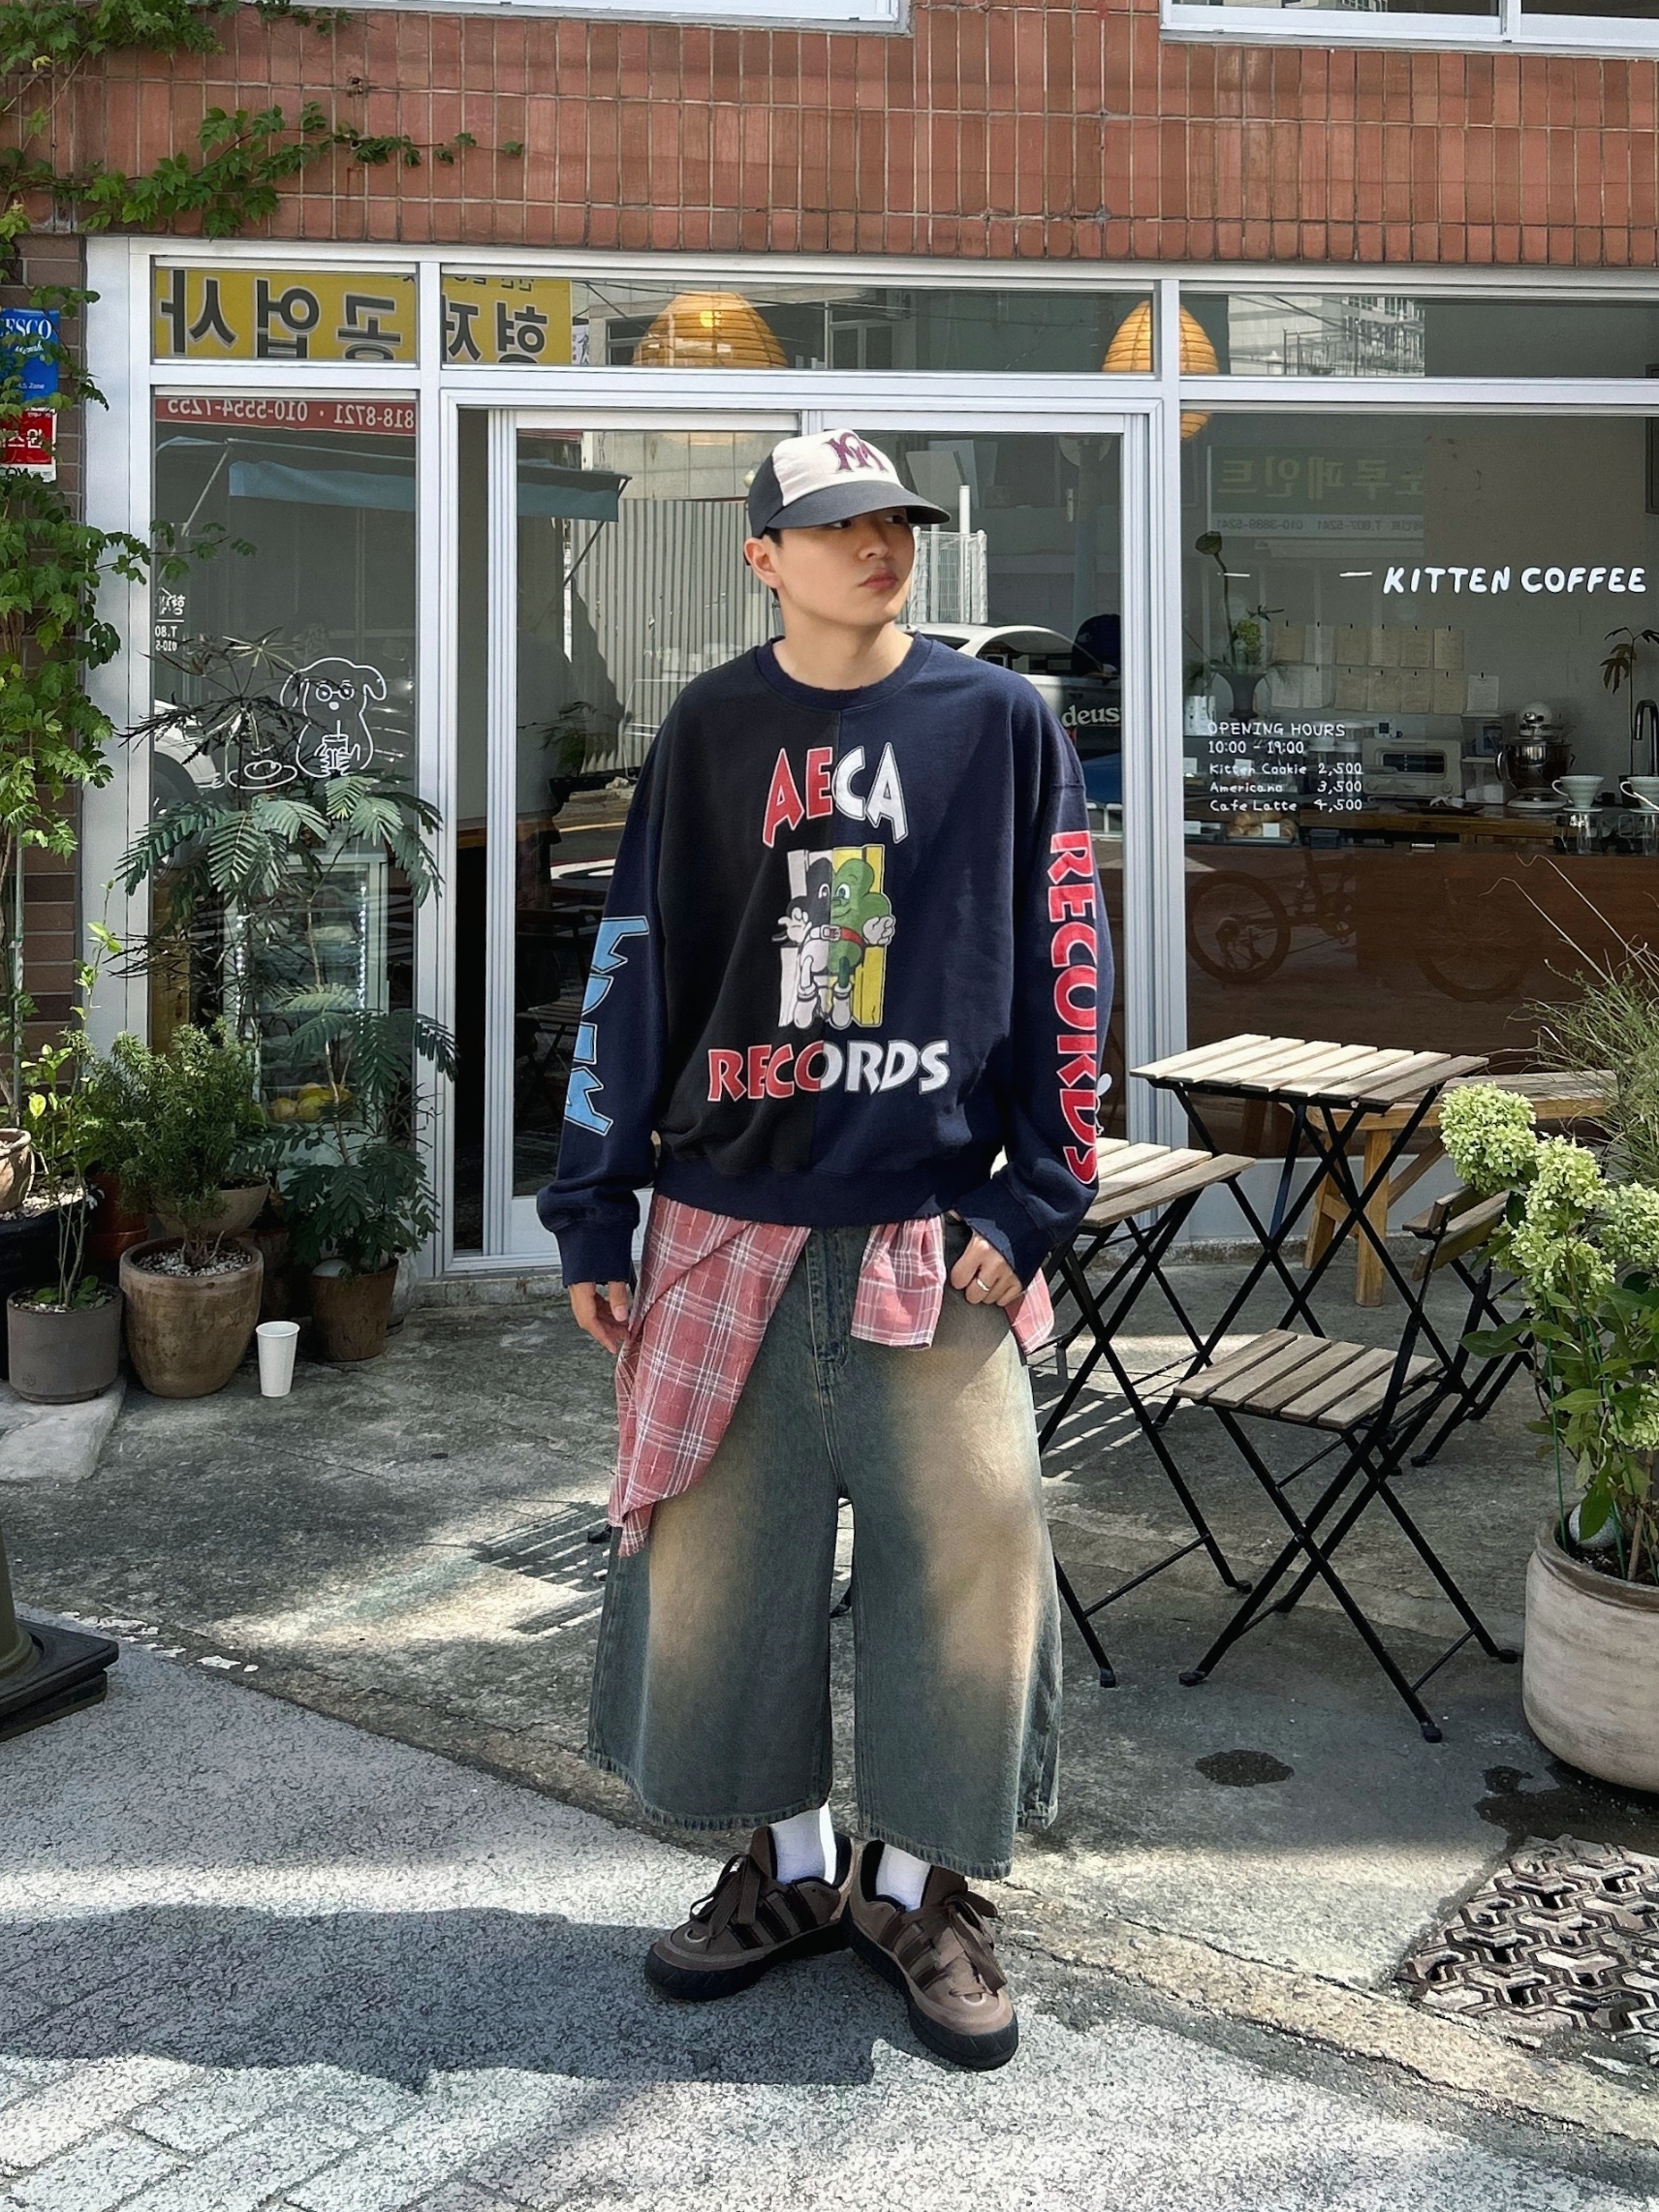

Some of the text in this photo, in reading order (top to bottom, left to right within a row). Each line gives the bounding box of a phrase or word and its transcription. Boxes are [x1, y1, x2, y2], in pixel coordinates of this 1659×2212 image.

[1383, 566, 1646, 594] KITTEN COFFEE
[1061, 704, 1121, 728] deus
[1207, 722, 1346, 736] OPENING HOURS
[1208, 740, 1247, 754] 10:00
[1267, 740, 1304, 755] 19:00
[1318, 763, 1363, 776] 2,500
[762, 741, 909, 849] AECA
[1209, 780, 1362, 795] Americano 3,500
[1209, 798, 1362, 813] Cafe Latte 4,500
[706, 1039, 951, 1102] RECORDS
